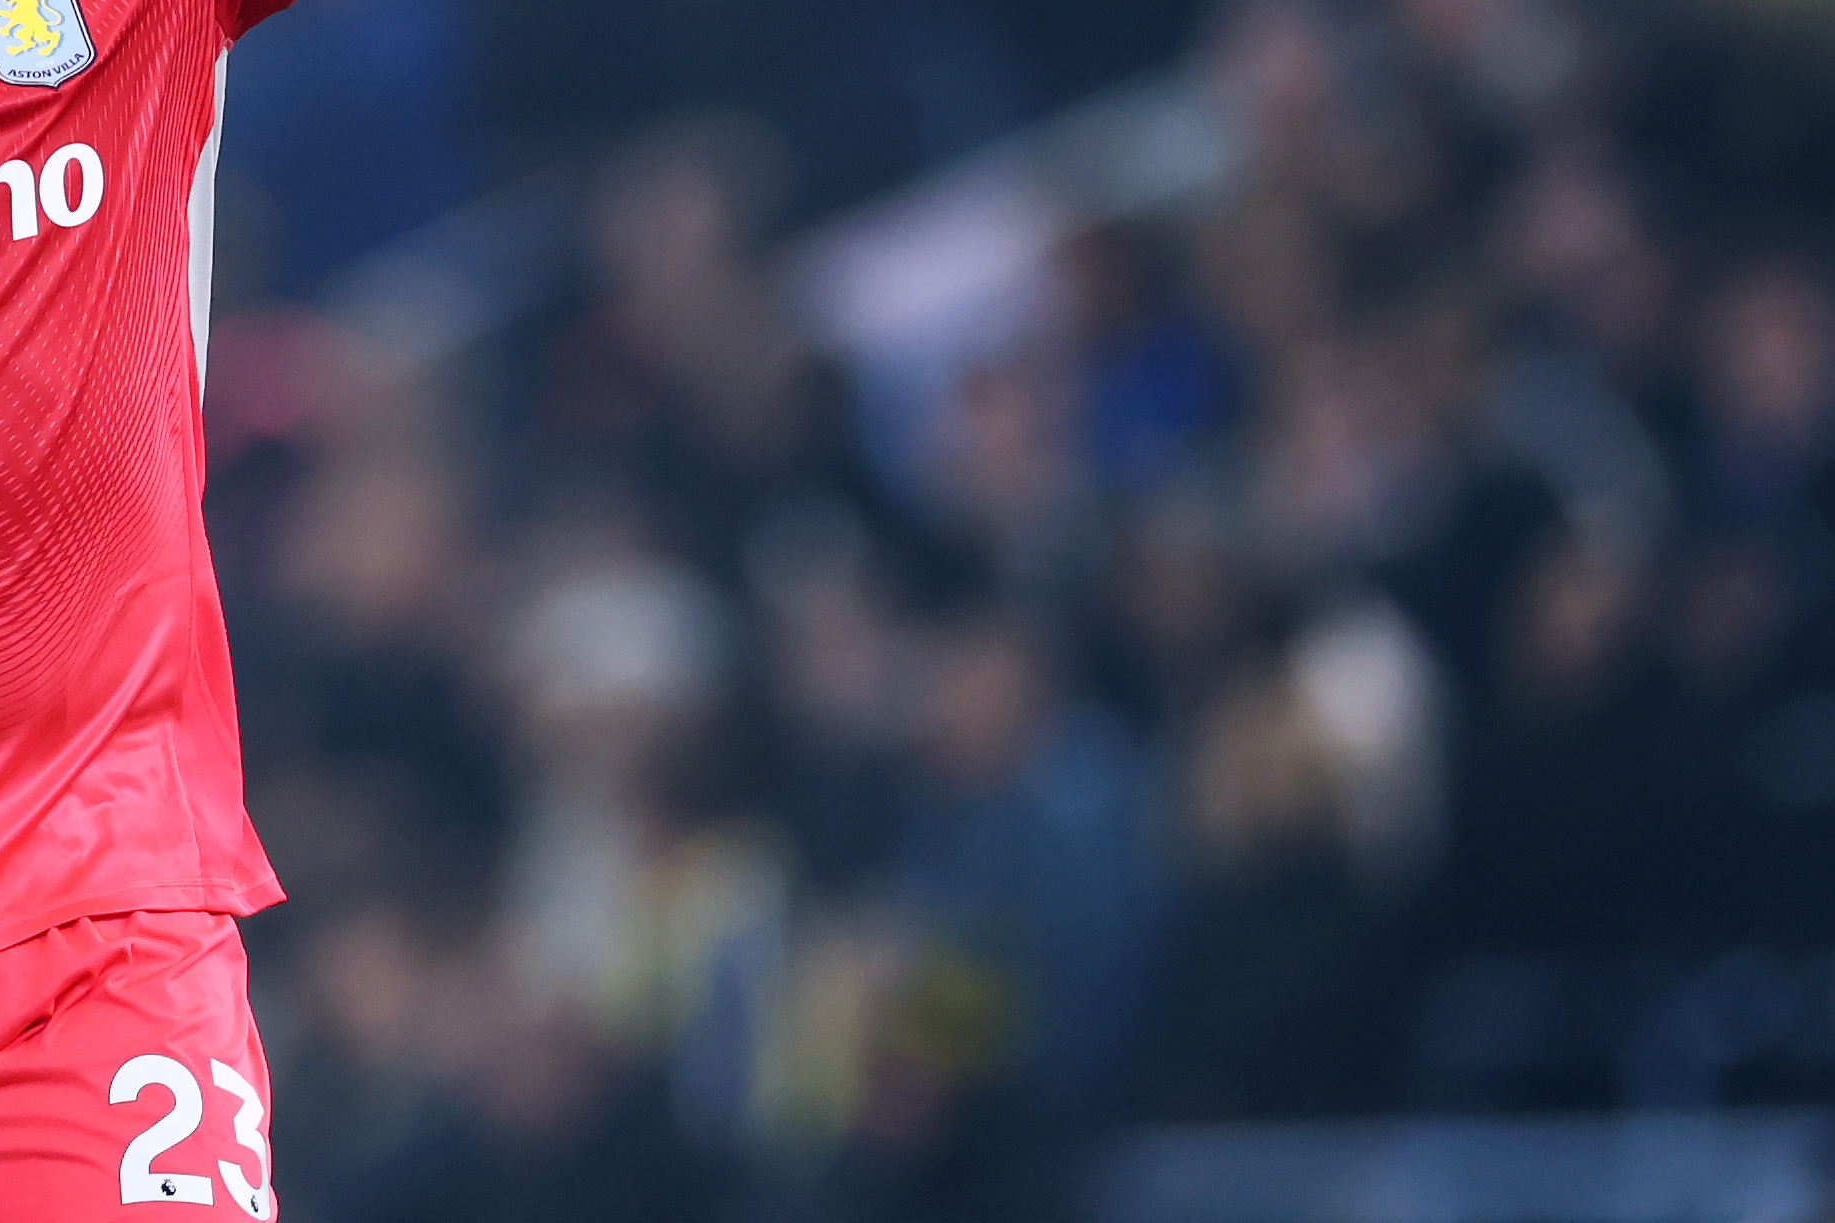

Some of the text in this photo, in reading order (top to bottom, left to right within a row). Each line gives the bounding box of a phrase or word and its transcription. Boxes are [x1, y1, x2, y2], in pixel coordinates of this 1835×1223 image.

[8, 68, 52, 78] ASTON
[52, 53, 84, 74] VILLA
[109, 1053, 271, 1222] 23
